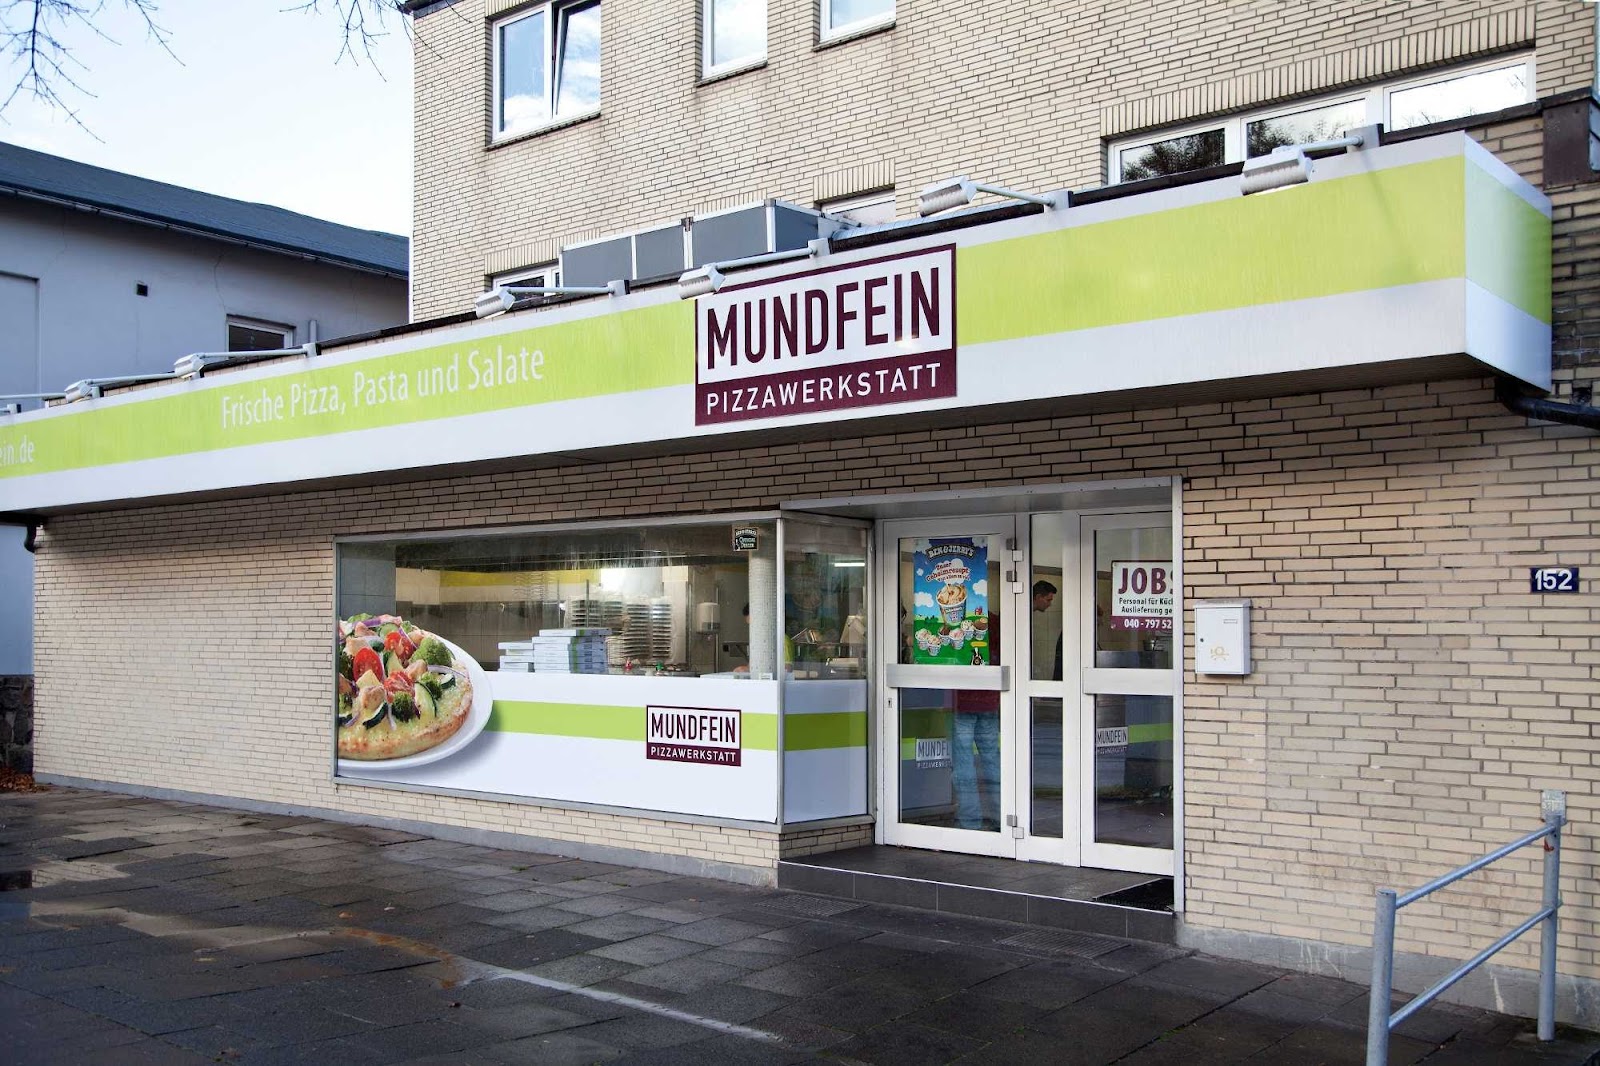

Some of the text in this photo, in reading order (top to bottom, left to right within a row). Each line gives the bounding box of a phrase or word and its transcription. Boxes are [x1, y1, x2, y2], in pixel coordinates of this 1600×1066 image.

[707, 267, 941, 370] MUNDFEIN
[221, 344, 545, 429] Frische Pizza, Pasta und Salate
[706, 362, 942, 416] PIZZAWERKSTATT
[1535, 568, 1573, 590] 152
[1118, 597, 1147, 605] Personal
[1148, 597, 1158, 605] für
[1121, 606, 1163, 615] Auslieferung
[1124, 619, 1140, 629] 040
[1145, 619, 1160, 629] 797
[1161, 619, 1172, 629] 52
[651, 712, 736, 743] MUNDFEIN
[650, 746, 736, 762] PIZZAWERKSTATT
